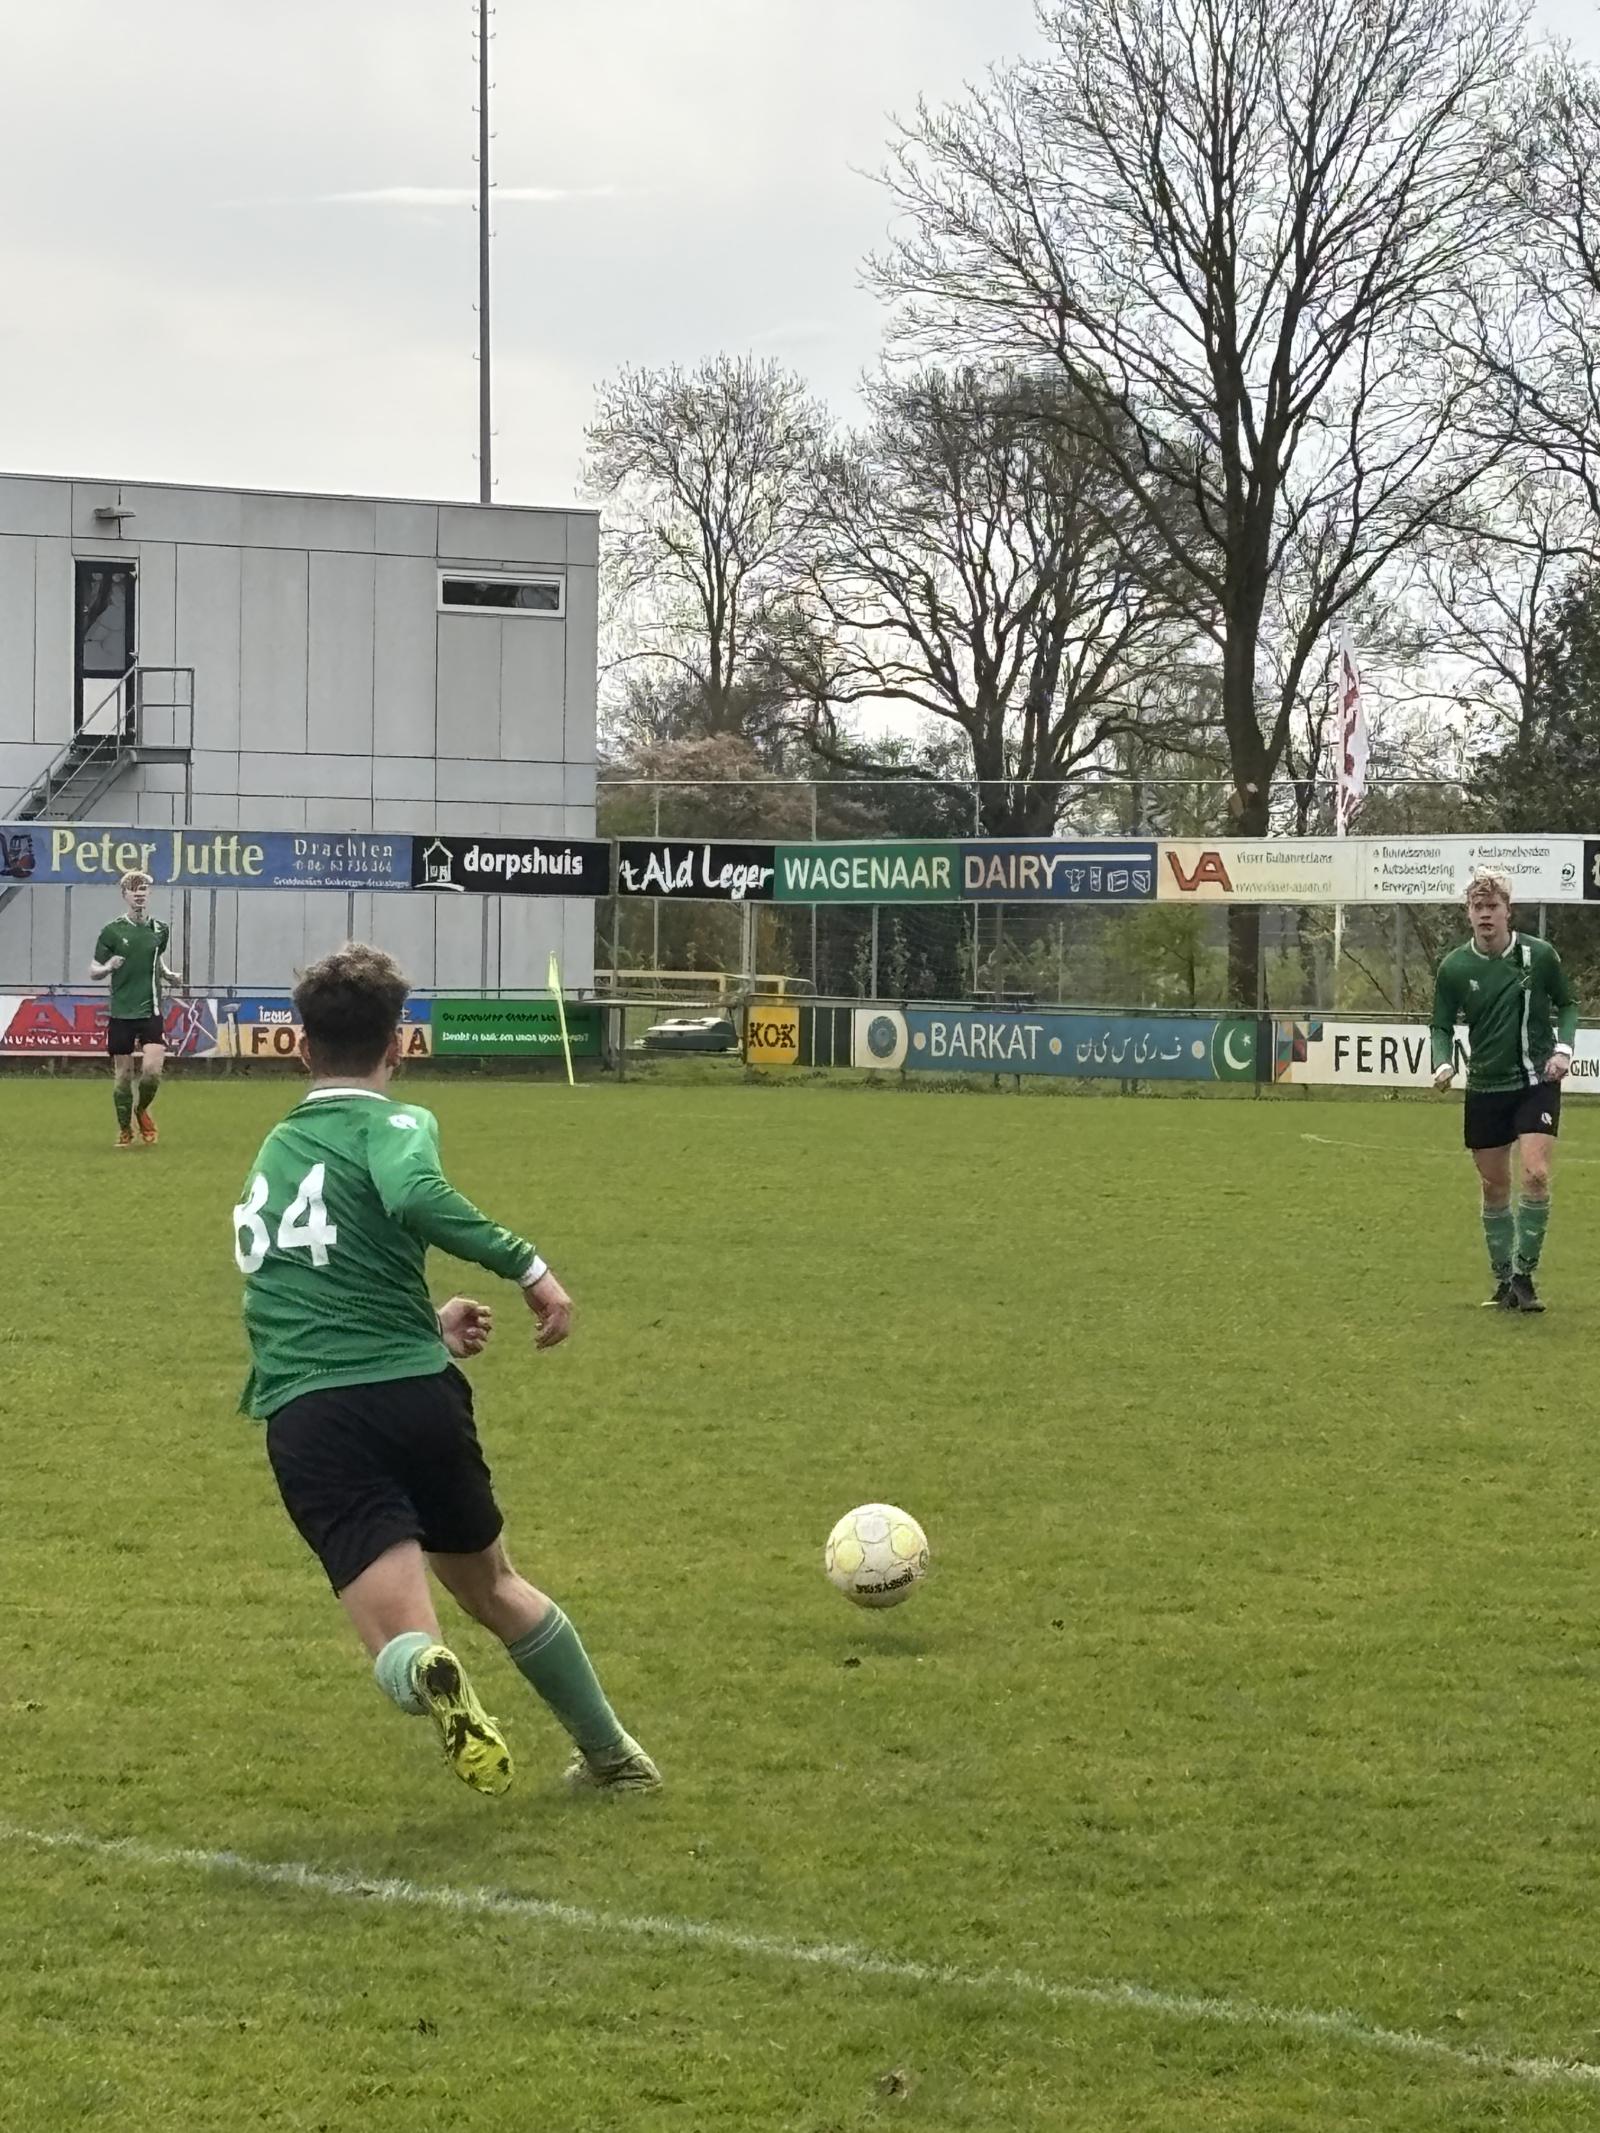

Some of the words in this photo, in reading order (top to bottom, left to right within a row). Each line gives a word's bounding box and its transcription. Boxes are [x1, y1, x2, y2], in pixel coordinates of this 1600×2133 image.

[51, 829, 156, 873] Peter
[167, 831, 264, 882] Jutte
[294, 837, 393, 858] Drachten
[464, 845, 583, 880] dorpshuis
[642, 847, 694, 893] Ald
[701, 844, 774, 900] Leger
[783, 855, 951, 890] WAGENAAR
[964, 854, 1058, 890] DAIRY
[1166, 851, 1234, 892] VA
[749, 1022, 797, 1049] KOK
[930, 1022, 1044, 1060] BARKAT
